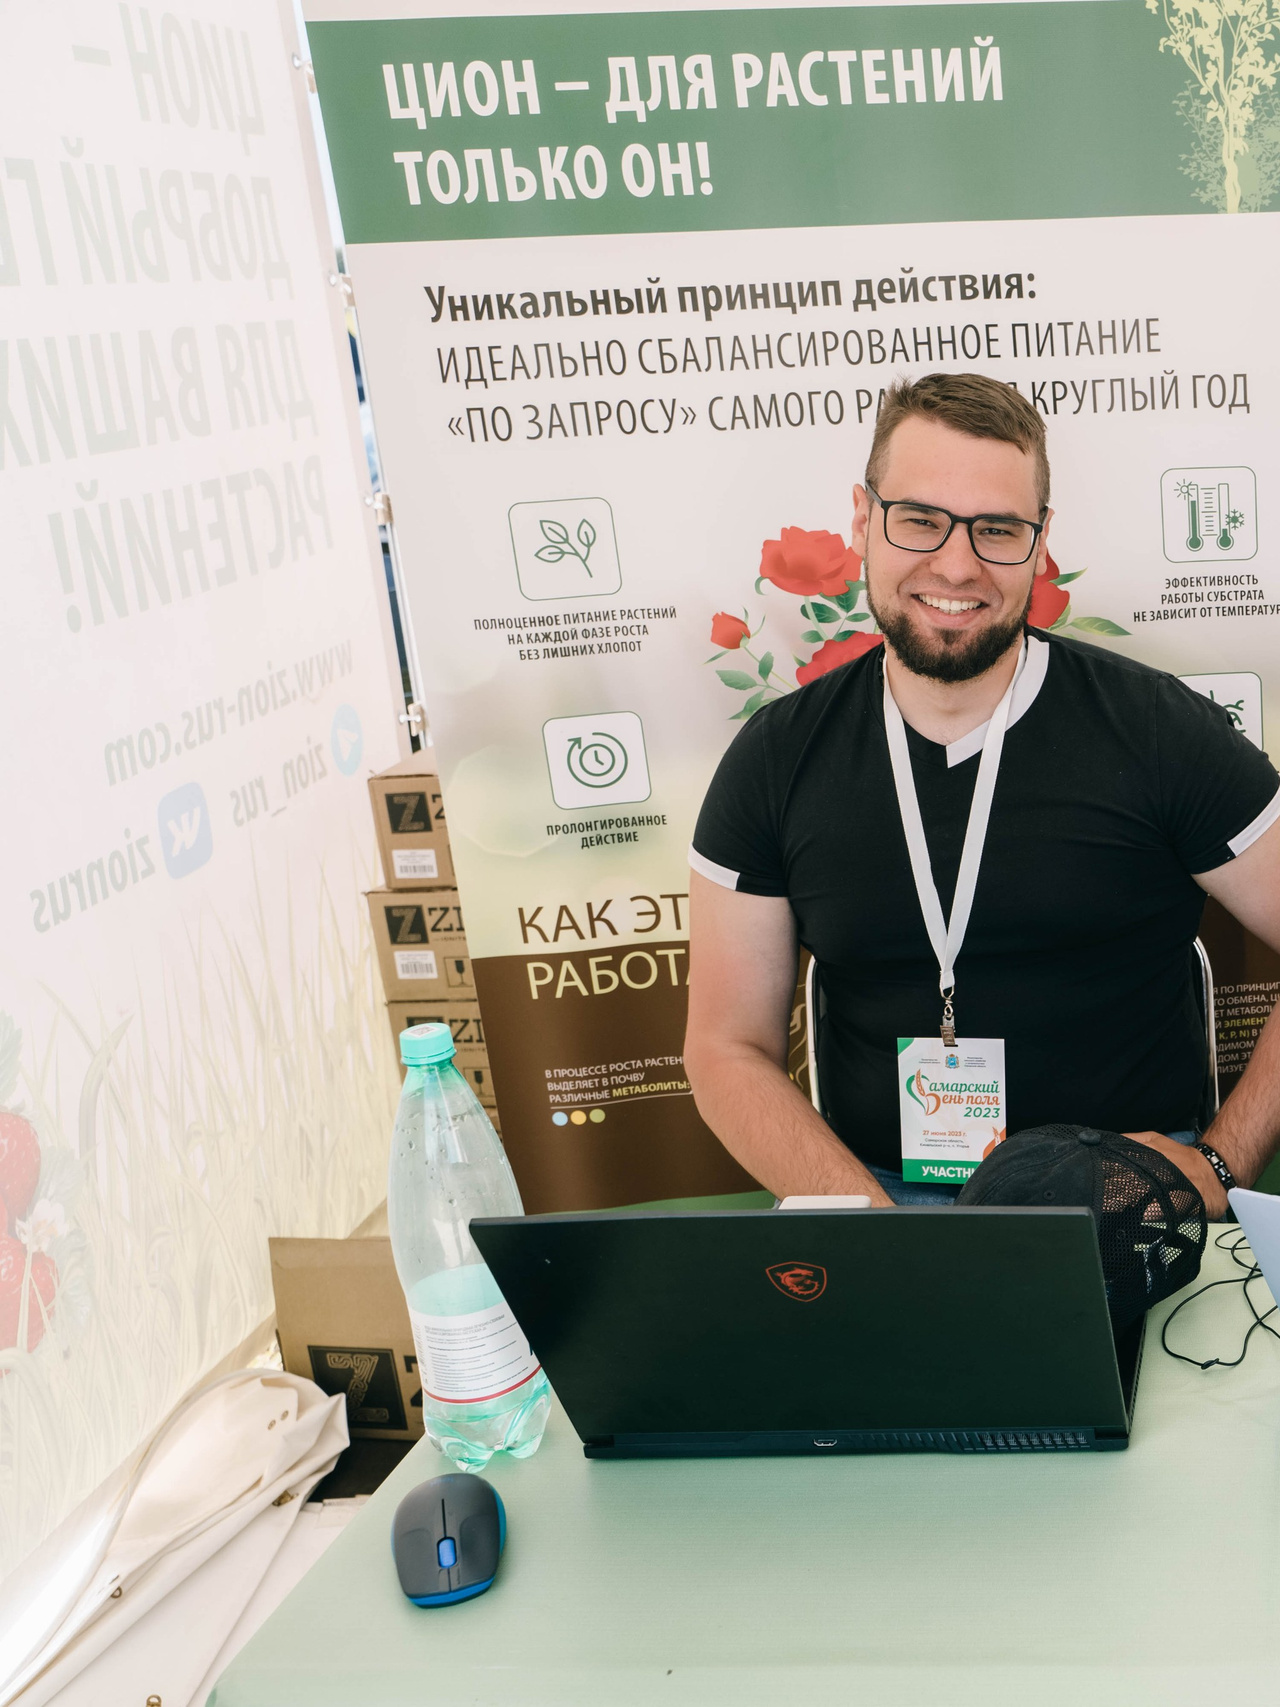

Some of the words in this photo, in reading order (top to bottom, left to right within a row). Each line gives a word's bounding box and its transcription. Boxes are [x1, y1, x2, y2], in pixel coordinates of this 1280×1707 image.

[382, 58, 541, 130] ЦИОН
[605, 54, 717, 125] ДЛЯ
[731, 35, 1004, 109] РАСТЕНИЙ
[393, 145, 609, 206] ТОЛЬКО
[621, 140, 714, 198] ОН!
[423, 276, 669, 325] Уникальный
[678, 281, 844, 322] принцип
[853, 266, 1038, 312] действия:
[436, 339, 628, 391] ИДЕАЛЬНО
[638, 324, 1001, 376] СБАЛАНСИРОВАННОЕ
[1010, 317, 1162, 359] ПИТАНИЕ
[446, 404, 513, 444] «ПО
[526, 398, 698, 442] ЗАПРОСУ»
[706, 390, 845, 433] САМОГО
[1031, 369, 1182, 416] КРУГЛЫЙ
[1190, 372, 1251, 414] ГОД
[1165, 574, 1259, 590] ЭФФЕКТИВНОСТЬ
[1160, 591, 1205, 605] РАБОТЫ
[1206, 589, 1265, 603] СУБСТРАТА
[473, 614, 562, 631] ПОЛНОЦЕННОЕ
[563, 609, 618, 625] ПИТАНИЕ
[619, 605, 678, 621] РАСТЕНИЙ
[1133, 611, 1148, 622] НЕ
[1149, 606, 1197, 621] ЗАВИСИТ
[1199, 606, 1214, 618] ОТ
[507, 633, 524, 646] НА
[526, 627, 579, 645] КАЖДОЙ
[581, 626, 613, 640] ФАЗЕ
[614, 624, 650, 638] РОСТА
[519, 648, 541, 662] БЕЗ
[542, 644, 596, 660] ЛИШНИХ
[596, 640, 643, 655] ХЛОПОТ
[546, 814, 668, 837] ПРОЛОНГИРОВАННОЕ
[580, 831, 640, 850] ДЕЙСТВИЕ
[518, 898, 619, 944] КАК
[629, 893, 689, 934] ЭТ
[526, 948, 690, 1000] РАБОТ
[1223, 1016, 1268, 1028] ЭЛЕМЕНТ
[553, 1063, 608, 1080] ПРОЦЕССЕ
[609, 1059, 643, 1073] РОСТА
[644, 1055, 684, 1068] РАСТЕН
[547, 1079, 600, 1092] ВЫДЕЛЯЕТ
[610, 1071, 646, 1085] ПОЧВУ
[549, 1089, 611, 1104] РАЗЛИЧНЫЕ
[612, 1081, 691, 1098] МЕТАБОЛИТЫ:
[966, 1095, 1001, 1106] поля
[963, 1106, 1001, 1119] 2023
[921, 1165, 975, 1179] УЧАСТН
